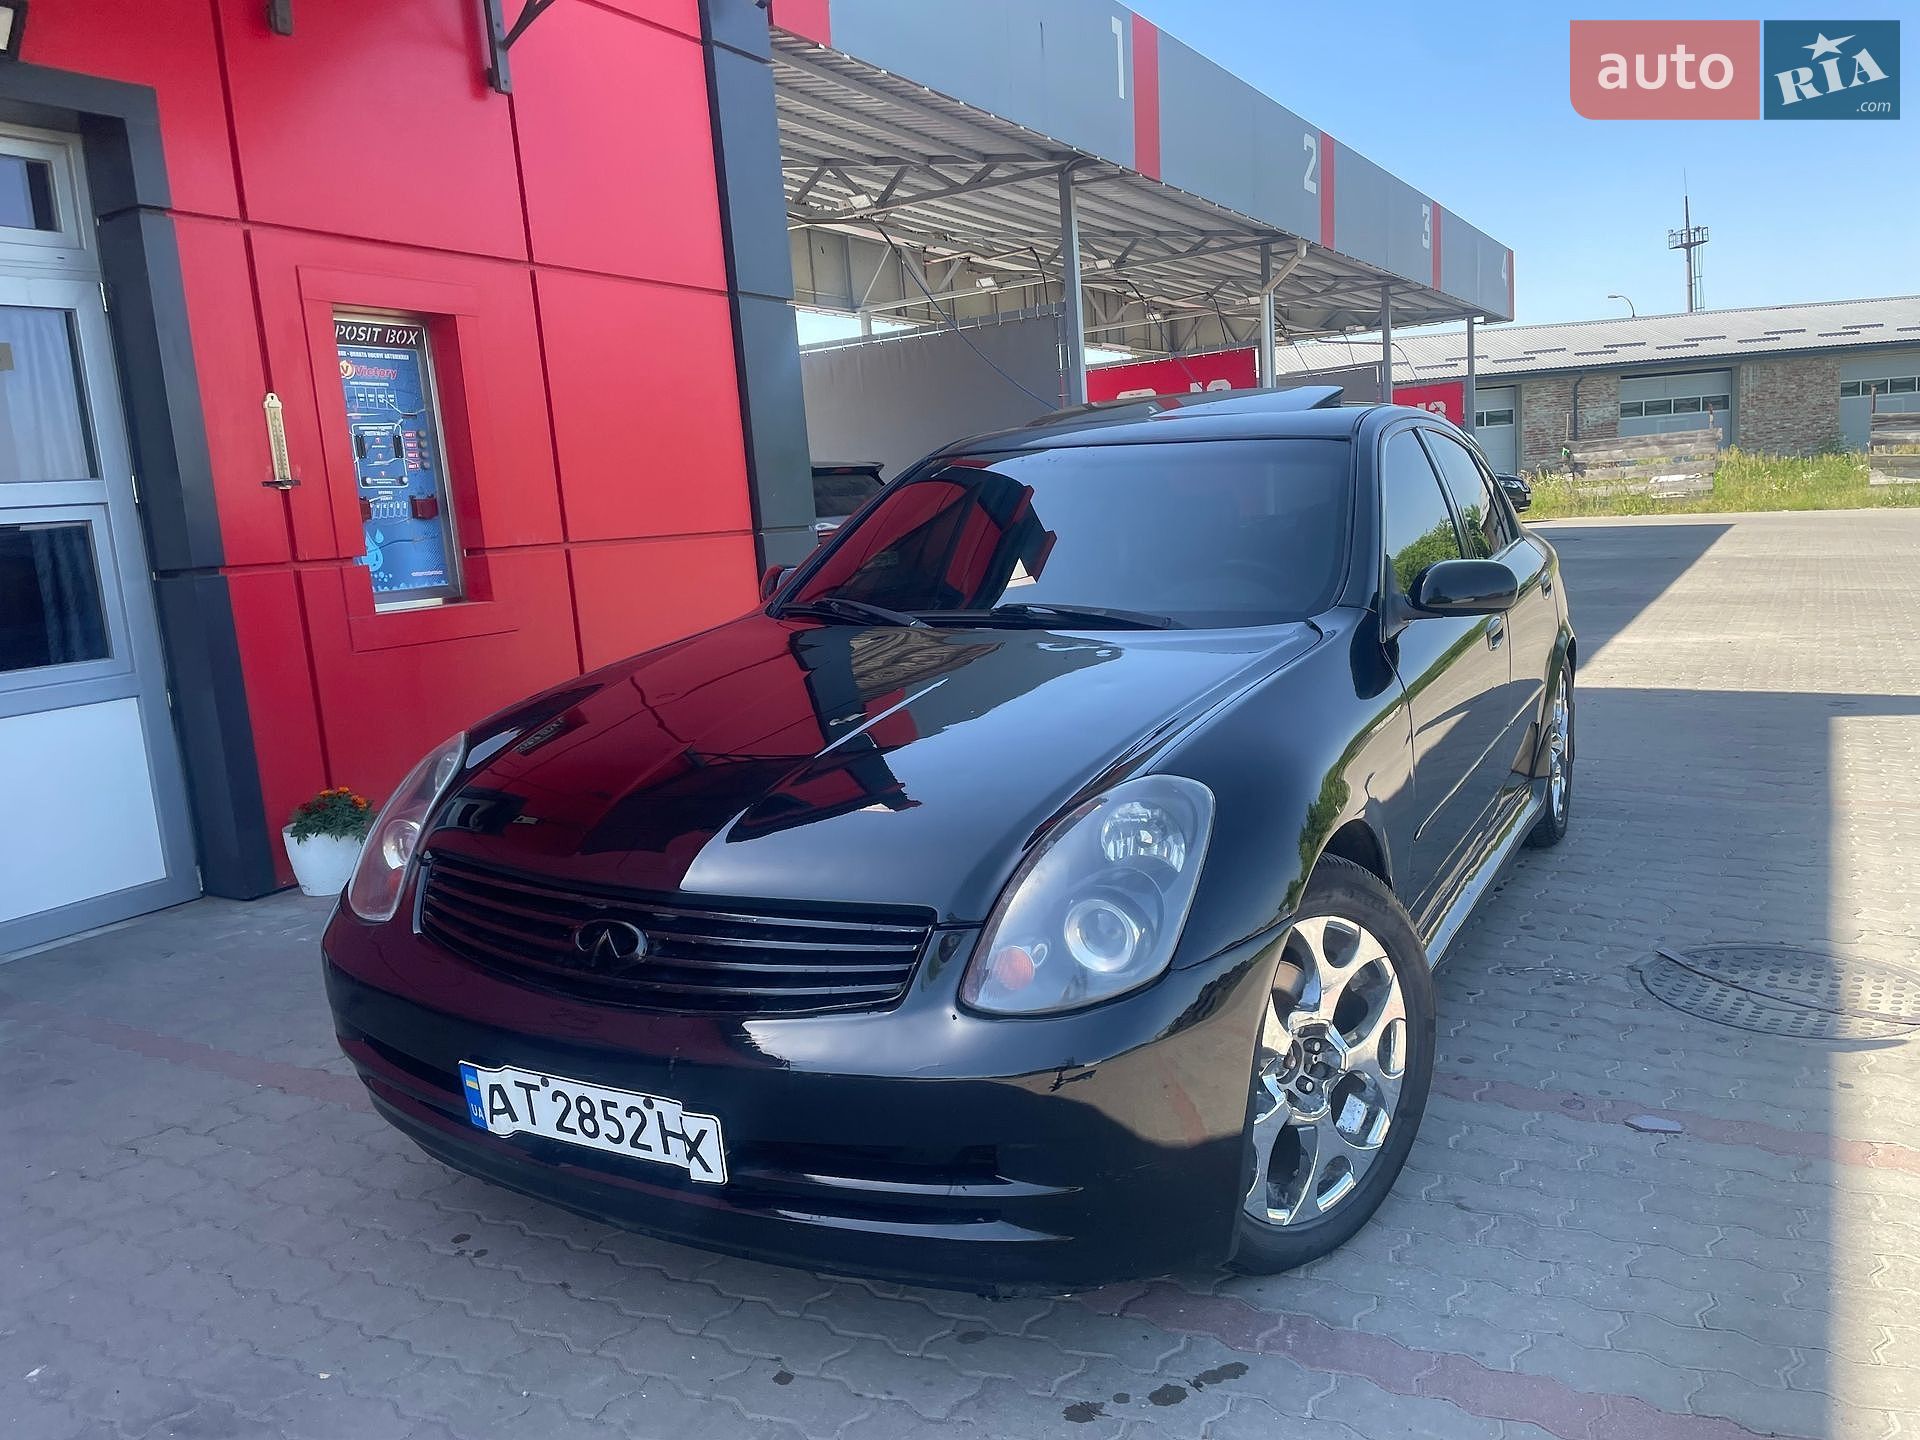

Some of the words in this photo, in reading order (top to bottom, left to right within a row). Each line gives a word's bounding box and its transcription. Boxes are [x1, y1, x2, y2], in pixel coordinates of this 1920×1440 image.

[1110, 16, 1125, 99] 1
[1303, 133, 1318, 194] 2
[1422, 203, 1431, 249] 3
[1501, 250, 1507, 288] 4
[385, 329, 418, 345] BOX
[471, 1103, 485, 1120] UA
[488, 1080, 540, 1126] AT
[551, 1089, 653, 1153] 2852
